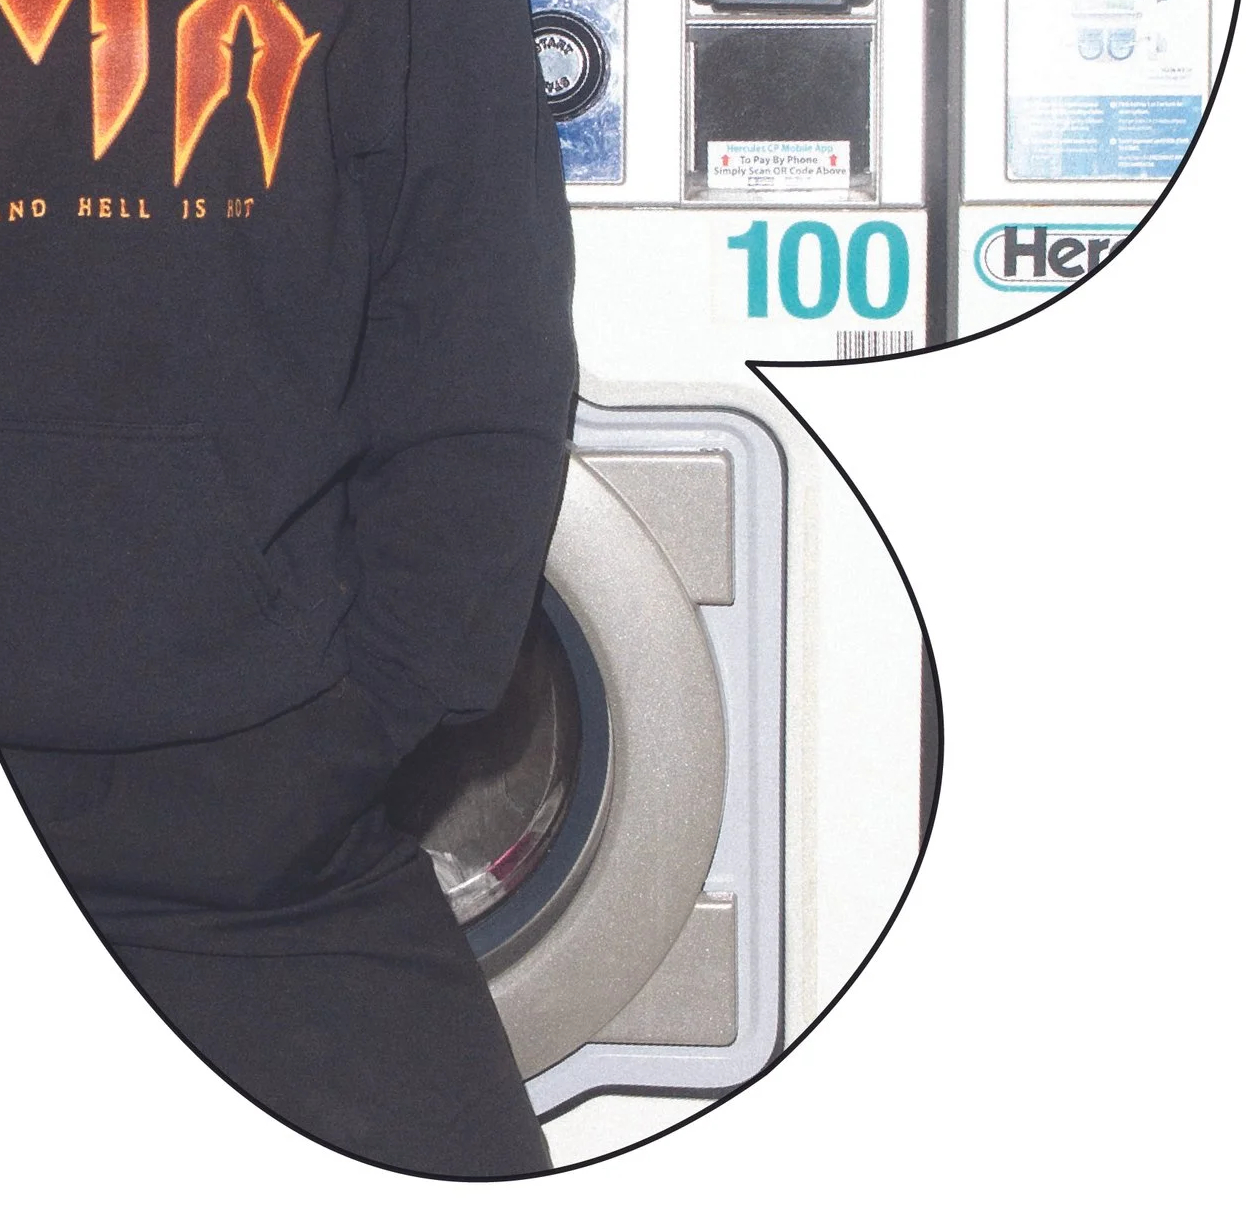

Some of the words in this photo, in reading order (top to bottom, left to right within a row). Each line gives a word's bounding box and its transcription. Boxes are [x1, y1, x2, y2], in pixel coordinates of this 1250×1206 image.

[726, 143, 766, 153] Hercules
[781, 143, 814, 153] Mobile
[815, 144, 834, 155] App
[740, 155, 751, 165] To
[753, 155, 770, 166] Pay
[772, 155, 785, 166] By
[787, 155, 818, 165] Phone
[713, 167, 747, 177] Simply
[749, 167, 771, 176] Scan
[789, 167, 814, 175] Code
[816, 167, 847, 175] Above
[77, 196, 151, 220] HELL
[181, 197, 207, 220] IS
[226, 196, 255, 220] HOT
[1003, 224, 1129, 279] Her
[726, 219, 911, 321] 100
